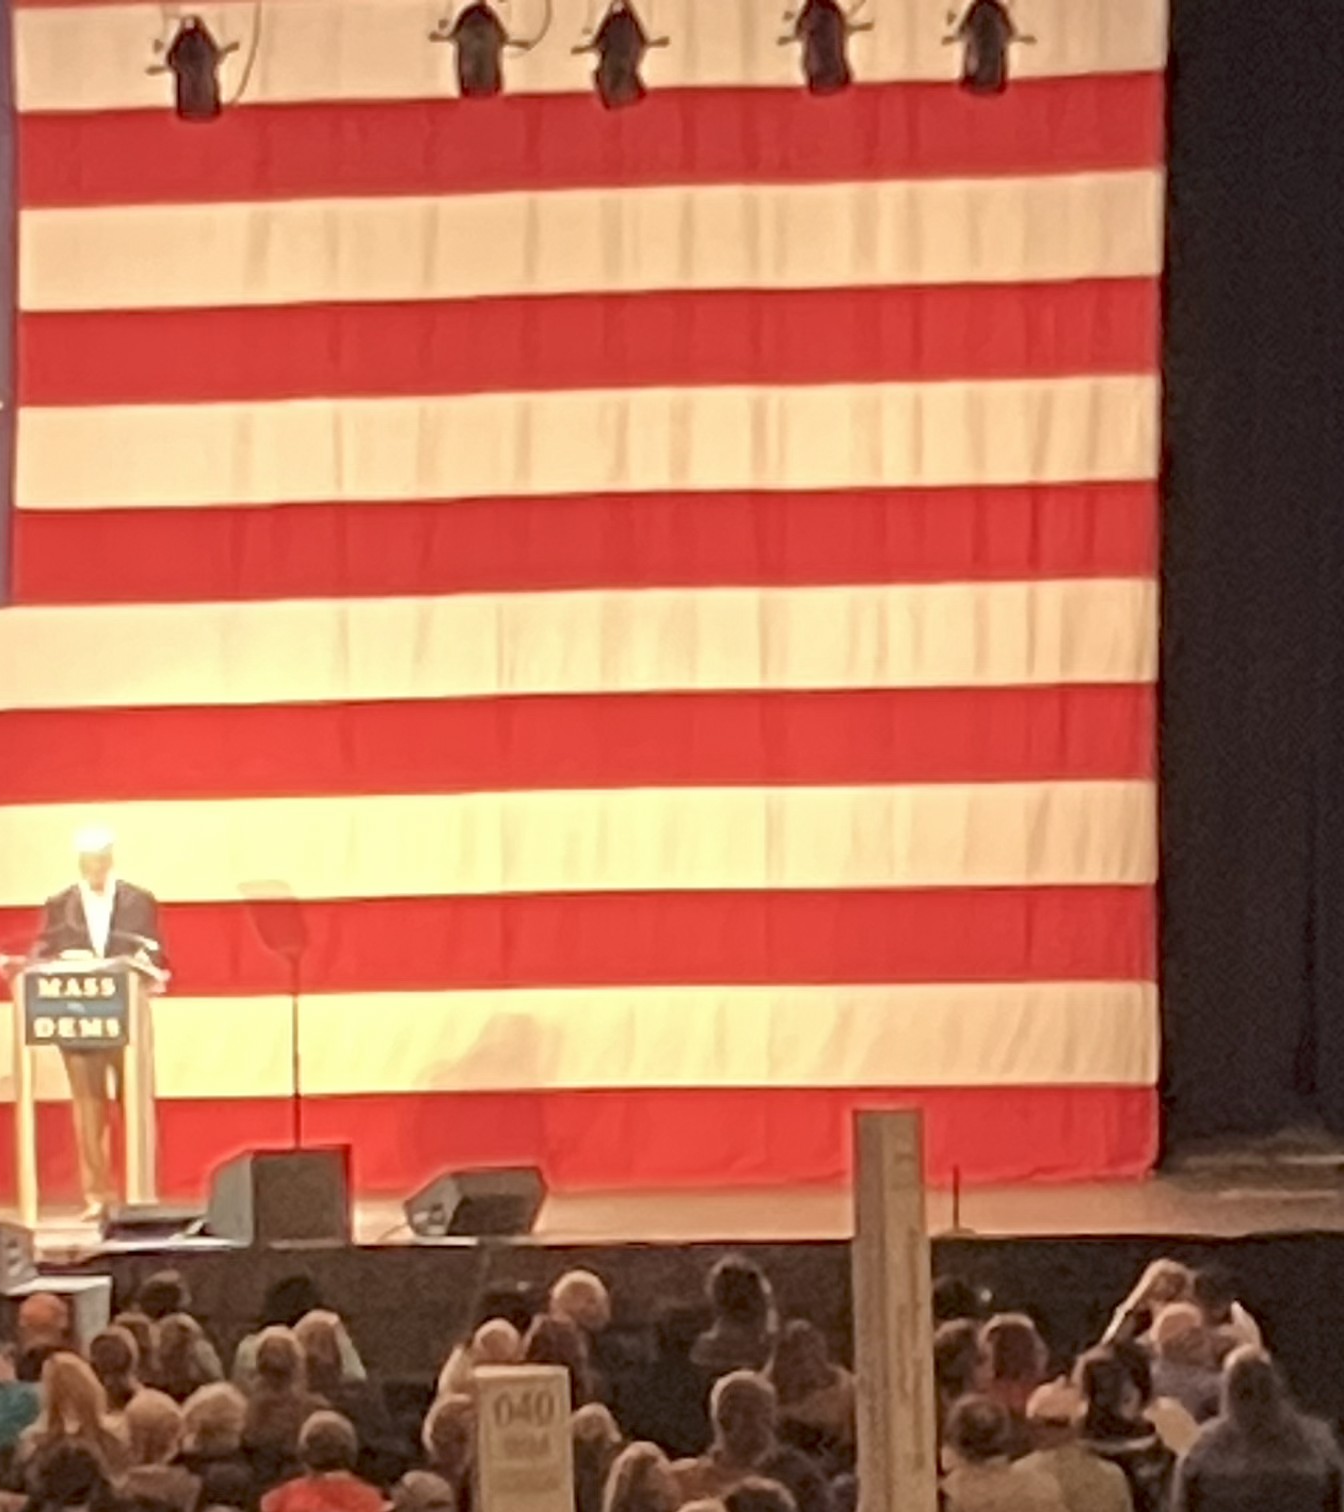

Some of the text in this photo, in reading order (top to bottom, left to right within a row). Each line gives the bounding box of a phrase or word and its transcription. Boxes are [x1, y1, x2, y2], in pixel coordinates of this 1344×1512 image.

[37, 977, 116, 998] MASS
[33, 1016, 120, 1039] DEMS
[493, 1390, 554, 1429] 040
